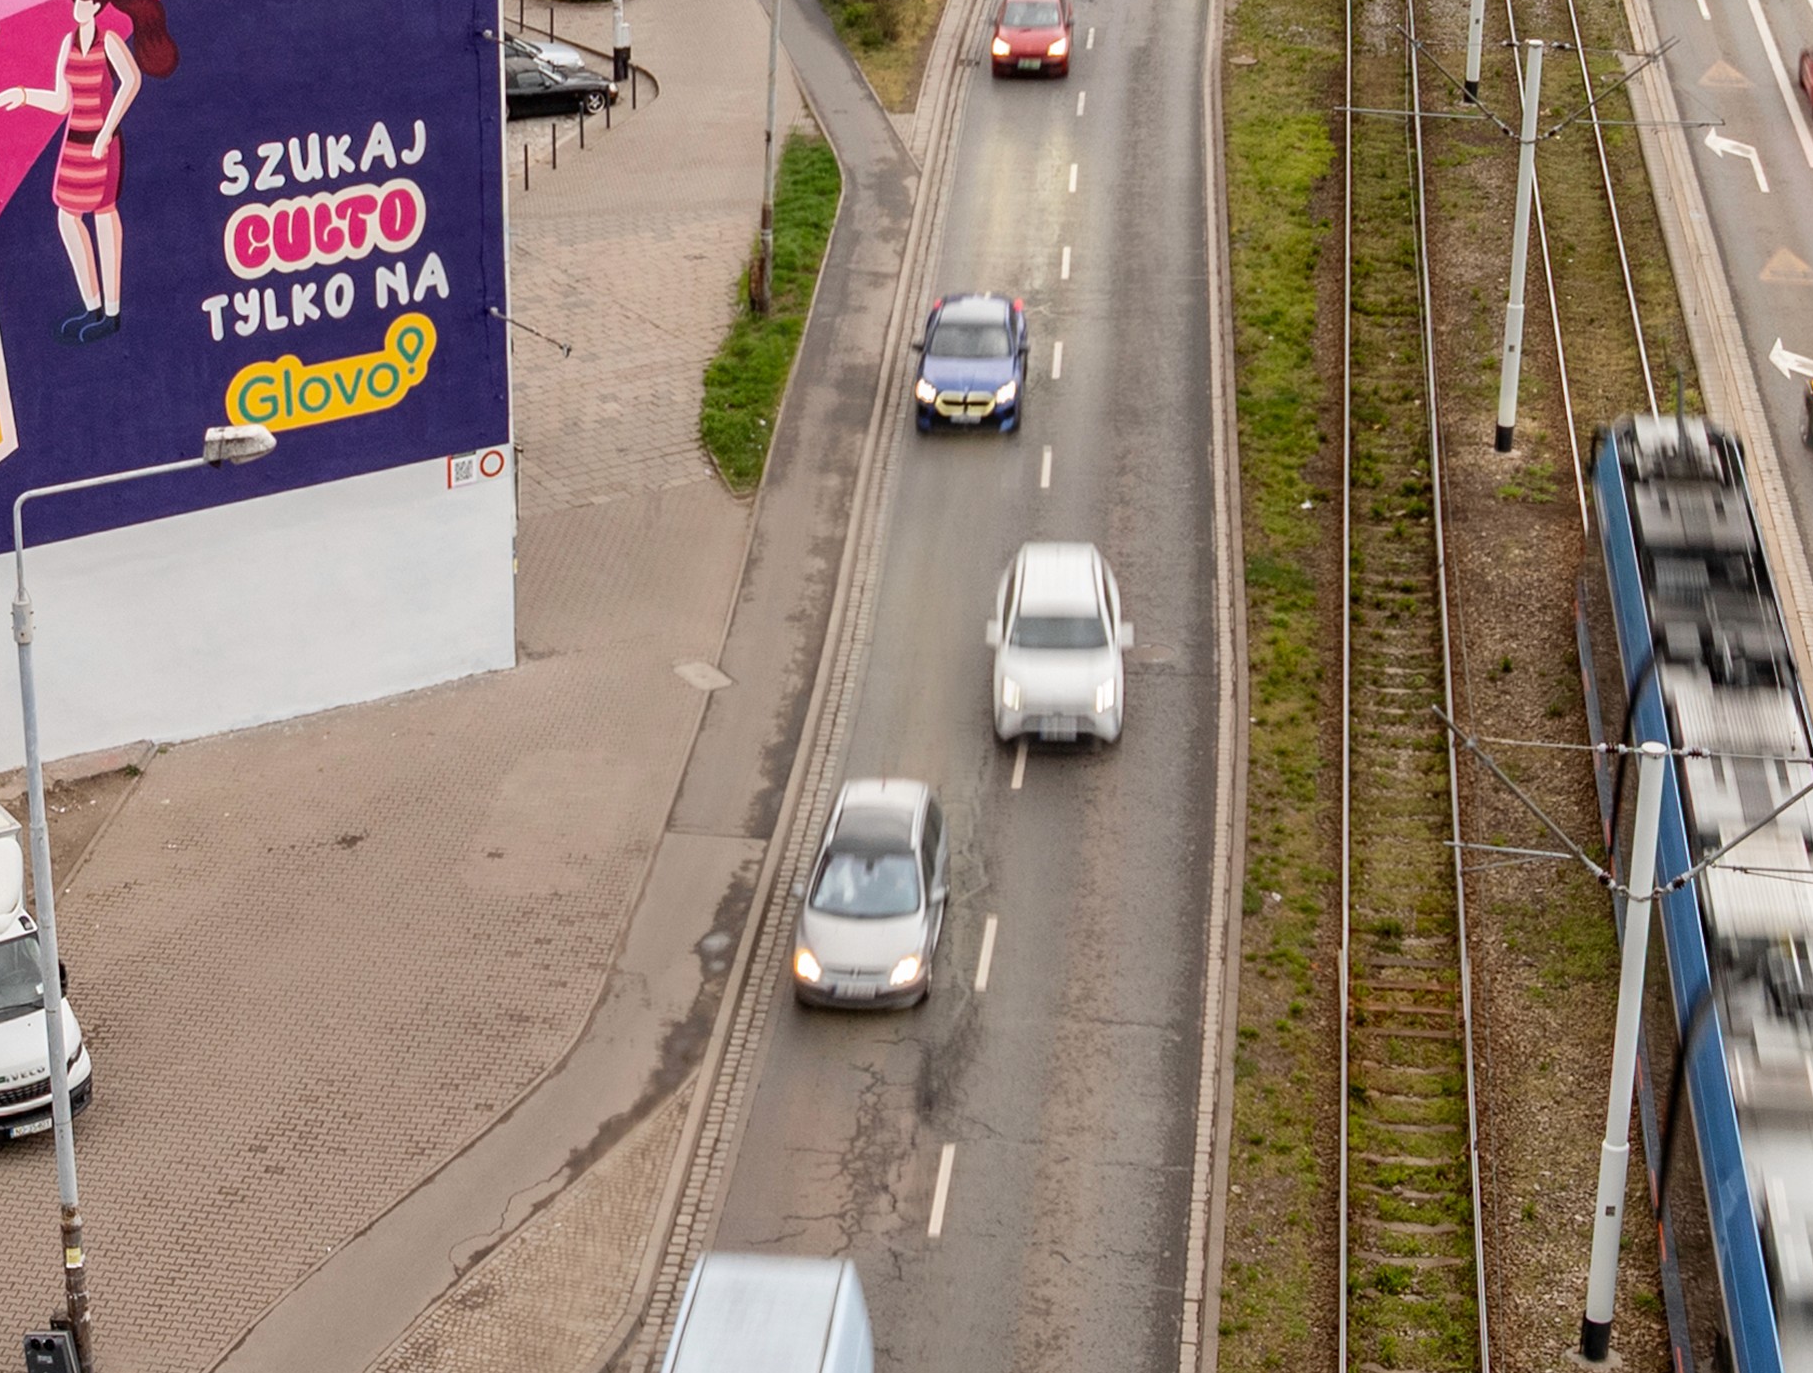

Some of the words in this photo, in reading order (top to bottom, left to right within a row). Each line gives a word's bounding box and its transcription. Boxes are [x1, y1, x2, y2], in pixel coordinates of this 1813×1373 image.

[220, 119, 427, 196] SZUKAJ
[230, 184, 421, 273] CULTO
[201, 272, 356, 342] TYLKO
[375, 251, 450, 309] NA
[238, 354, 402, 423] Glovo
[6, 1066, 46, 1083] IVECO
